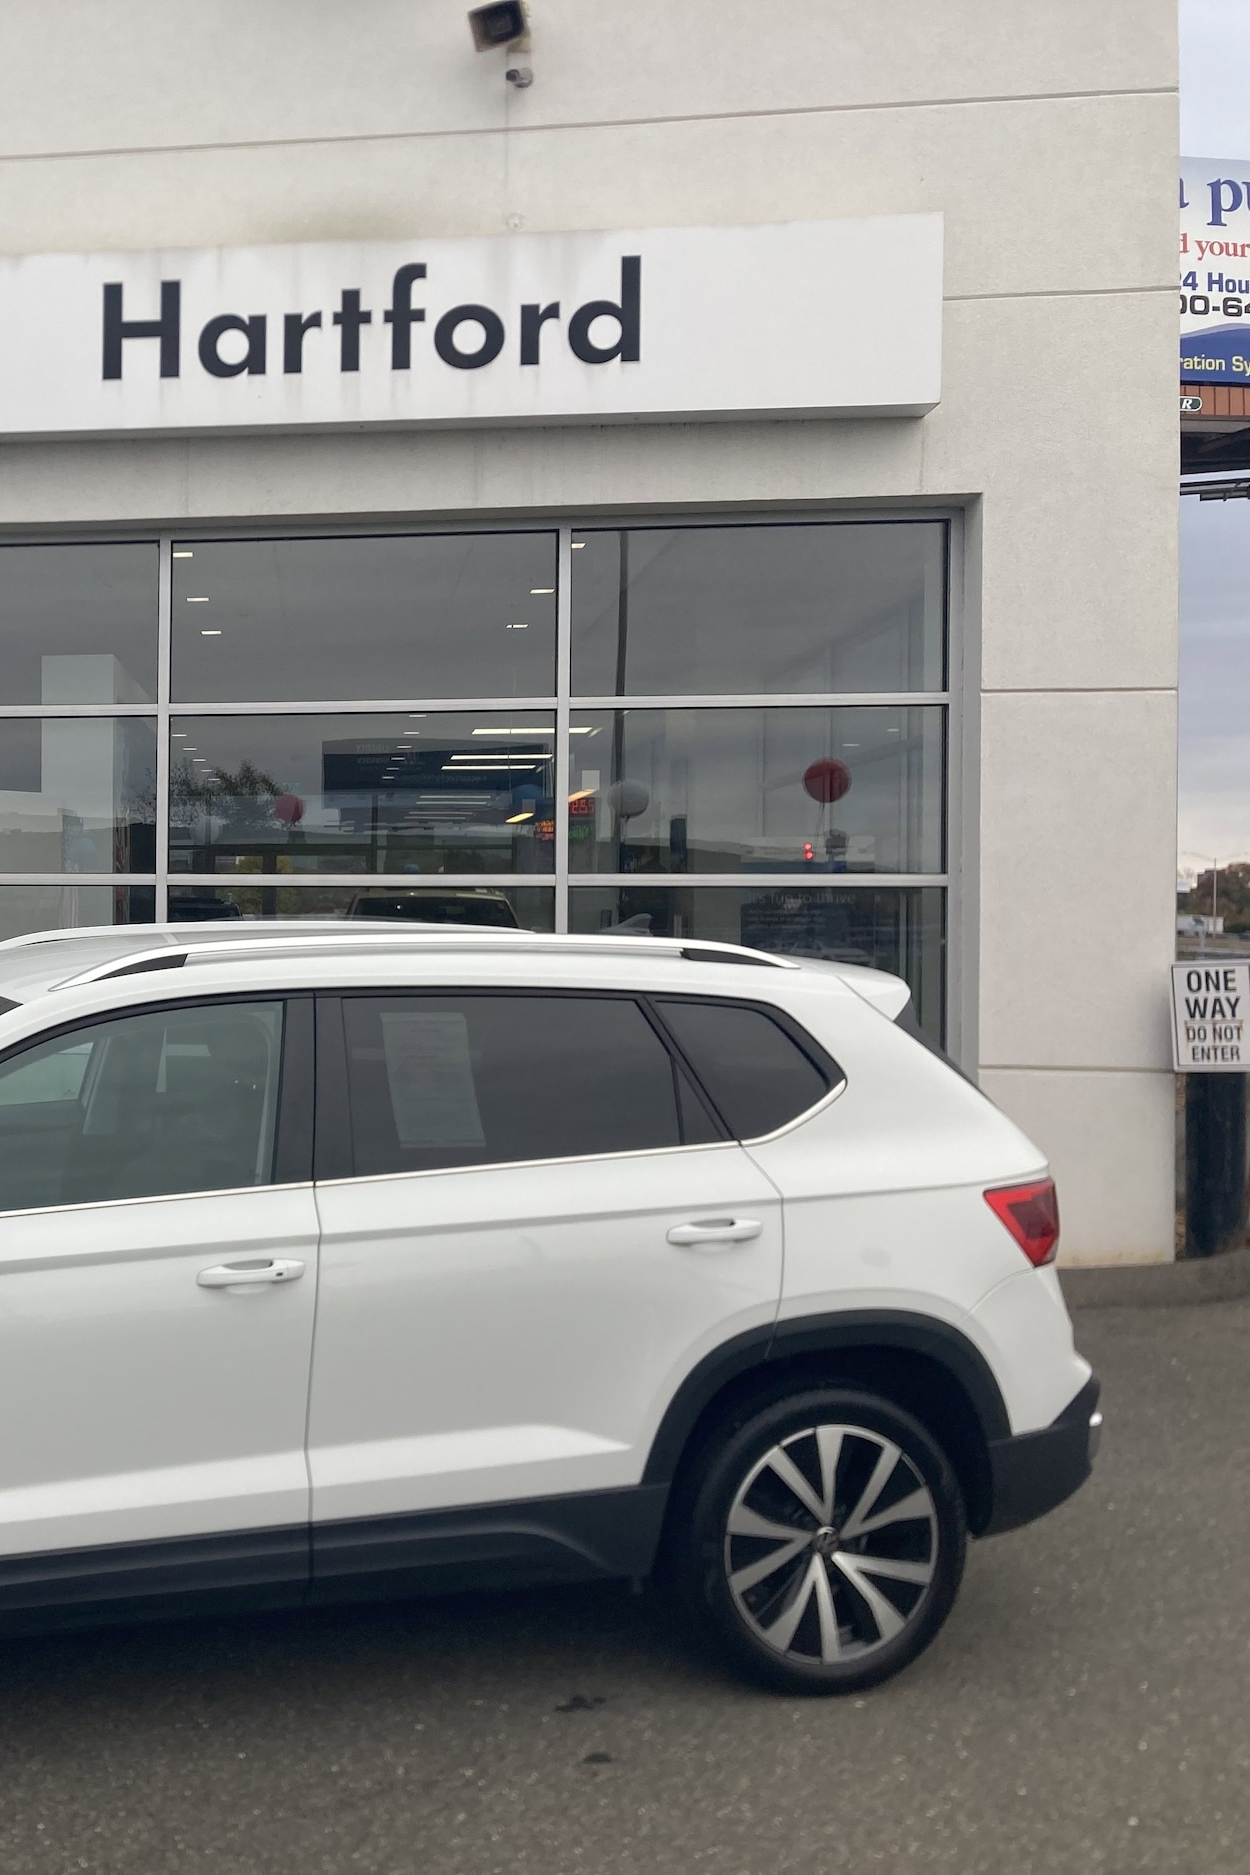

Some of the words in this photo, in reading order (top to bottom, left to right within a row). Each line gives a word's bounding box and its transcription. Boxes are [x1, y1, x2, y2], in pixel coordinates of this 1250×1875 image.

[1194, 239, 1250, 261] your
[102, 255, 642, 380] Hartford
[1186, 969, 1238, 993] ONE
[1185, 996, 1241, 1020] WAY
[1187, 1025, 1207, 1043] DO
[1213, 1025, 1241, 1043] NOT
[1191, 1045, 1240, 1062] ENTER
